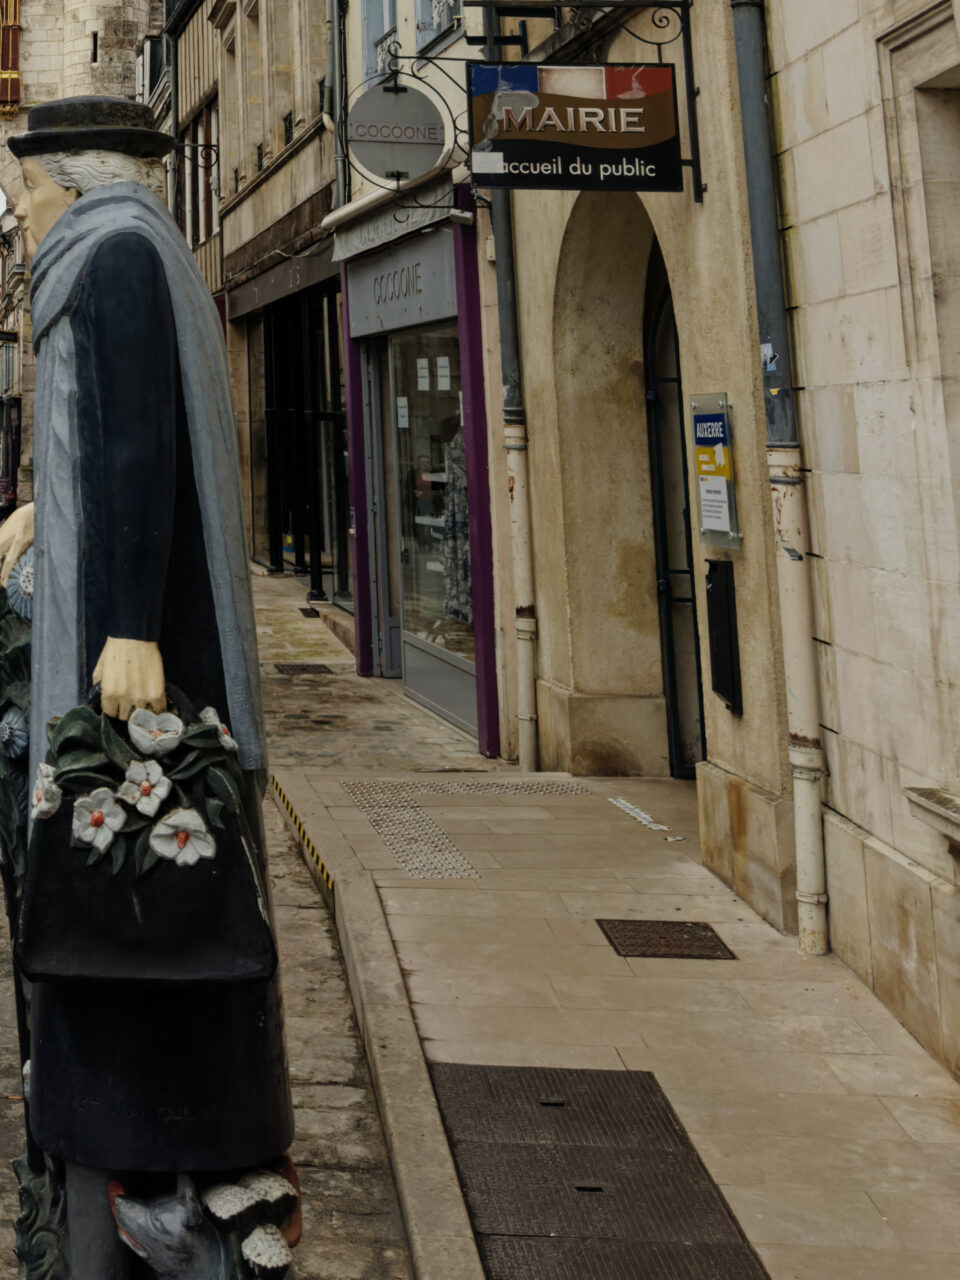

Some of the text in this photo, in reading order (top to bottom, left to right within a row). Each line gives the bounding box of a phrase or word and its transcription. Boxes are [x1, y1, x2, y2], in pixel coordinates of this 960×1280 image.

[355, 124, 438, 140] COCOONE
[502, 106, 646, 133] MAIRIE
[568, 156, 593, 176] du
[599, 157, 657, 181] public
[373, 262, 422, 304] COCOONE
[696, 422, 724, 438] AUXERRE
